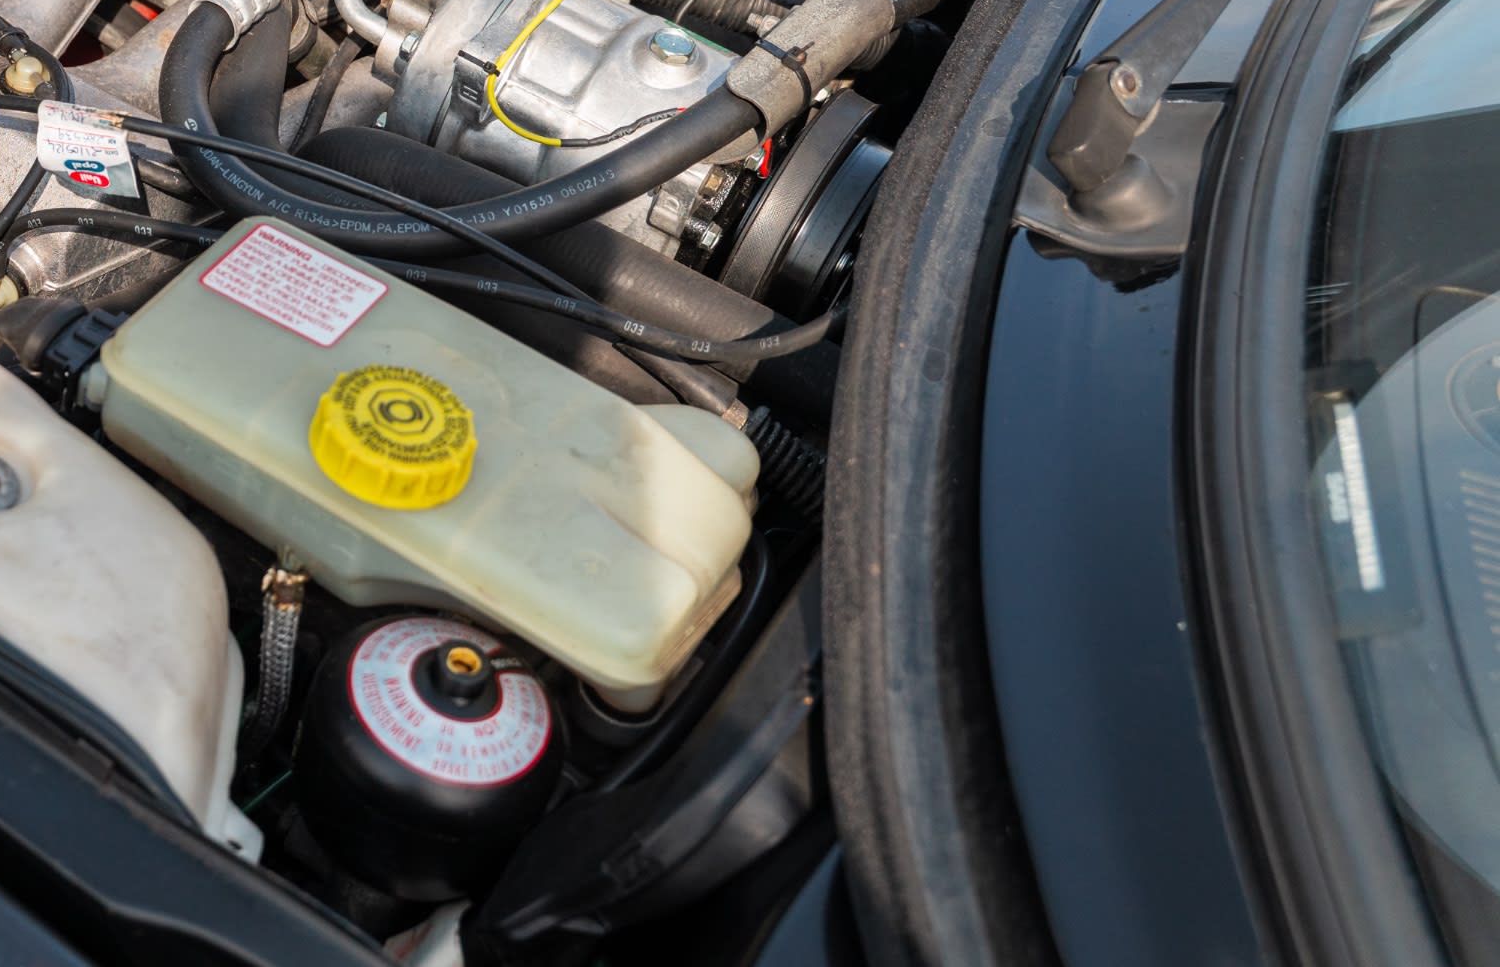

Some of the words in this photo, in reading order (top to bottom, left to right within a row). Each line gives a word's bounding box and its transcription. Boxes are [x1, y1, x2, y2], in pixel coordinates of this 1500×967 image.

[79, 173, 103, 185] Unil
[197, 146, 265, 202] ODAN-LINGYUN
[267, 198, 291, 215] A/C
[134, 225, 154, 237] ECO
[257, 229, 313, 261] WARNING
[405, 269, 428, 283] ECO
[623, 320, 645, 337] ECO
[691, 340, 711, 354] ECO
[383, 676, 426, 729] WARNING
